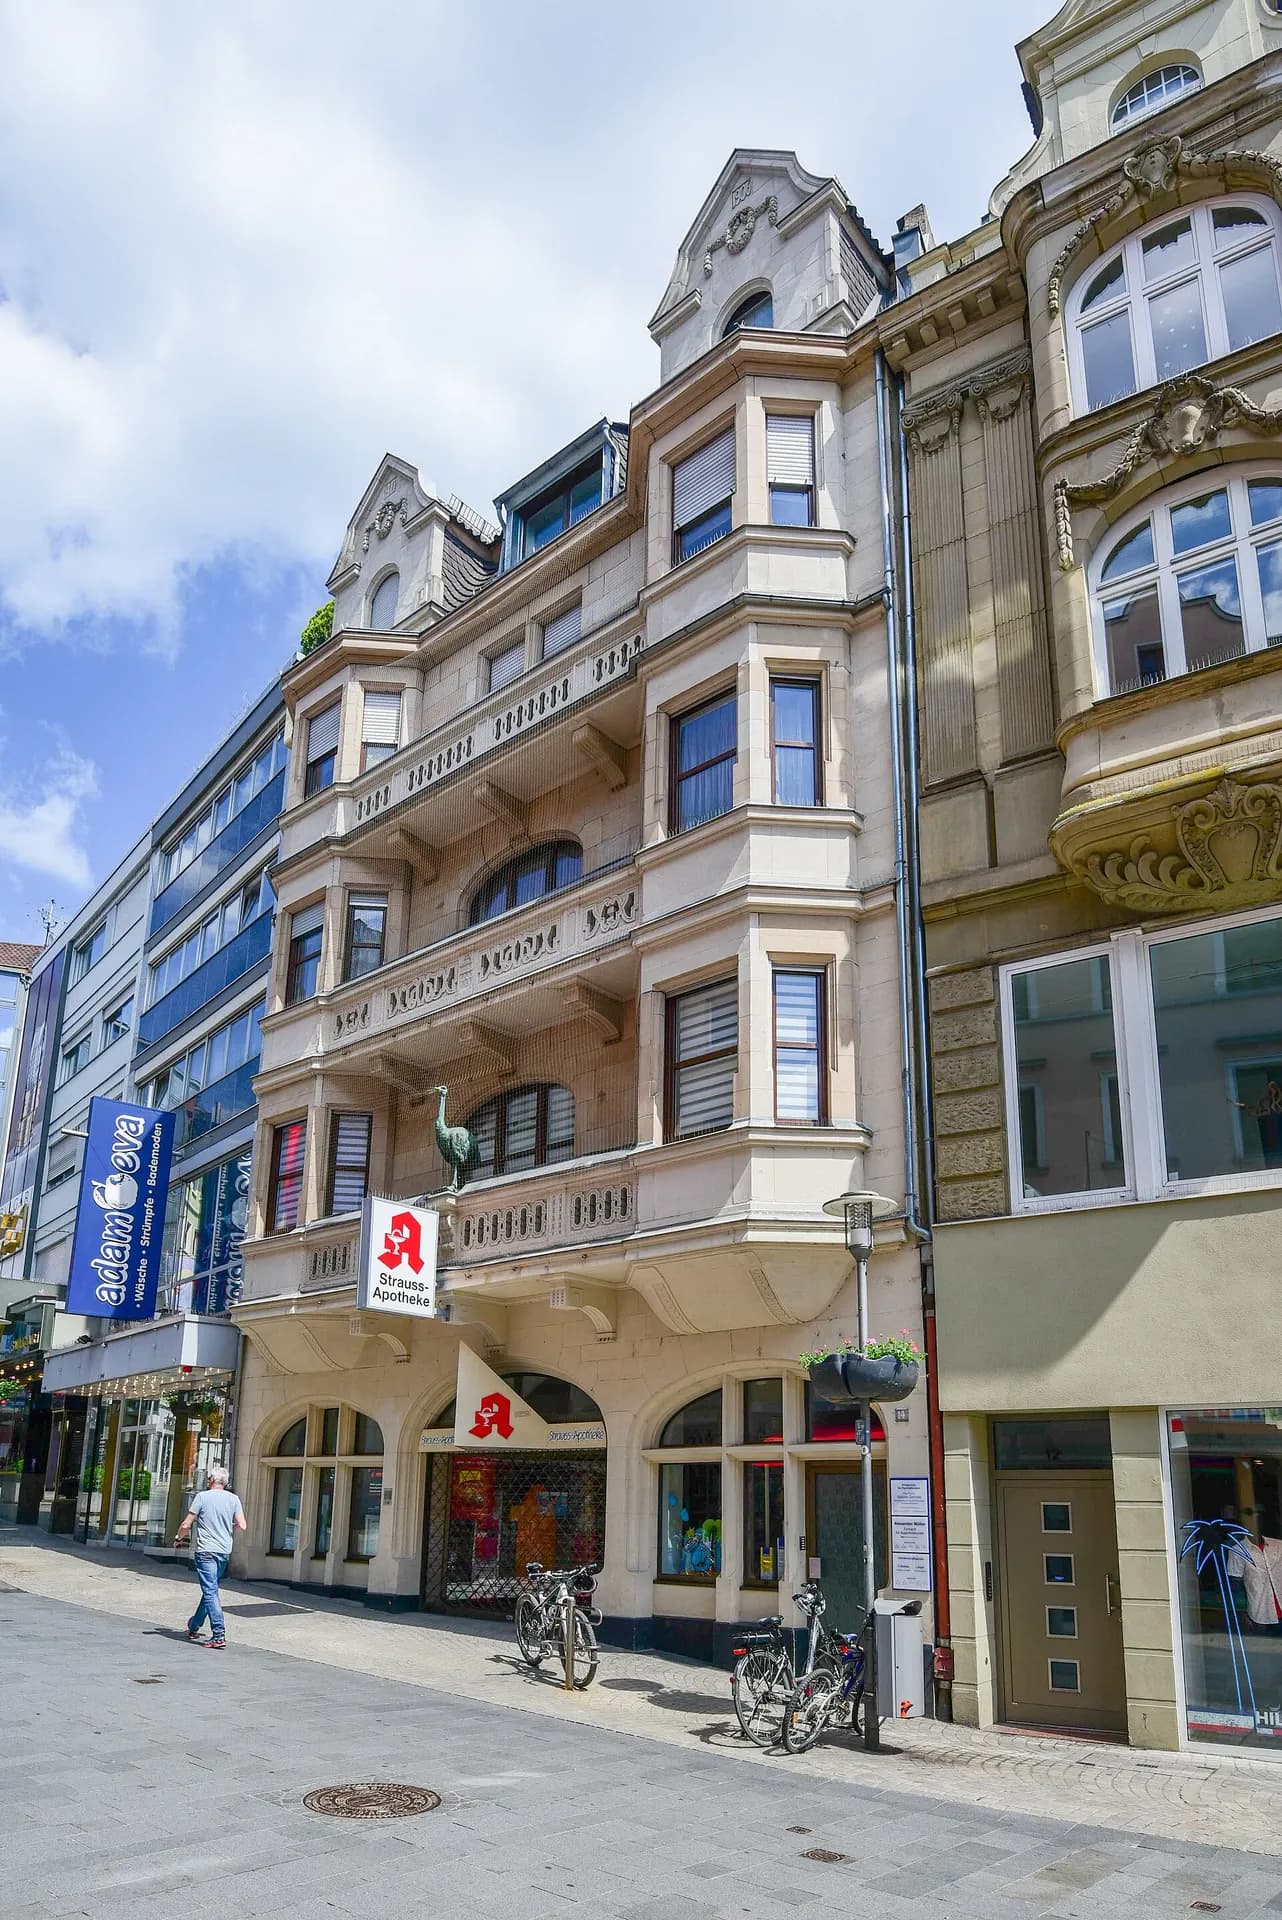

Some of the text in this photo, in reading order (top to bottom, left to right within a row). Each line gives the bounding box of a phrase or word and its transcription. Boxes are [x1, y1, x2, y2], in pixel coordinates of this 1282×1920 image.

[91, 1114, 145, 1307] adam eva
[134, 1123, 163, 1303] Wäsche Strümpfe Bademoden
[372, 1287, 430, 1307] Apotheke
[379, 1272, 430, 1292] Strauss-
